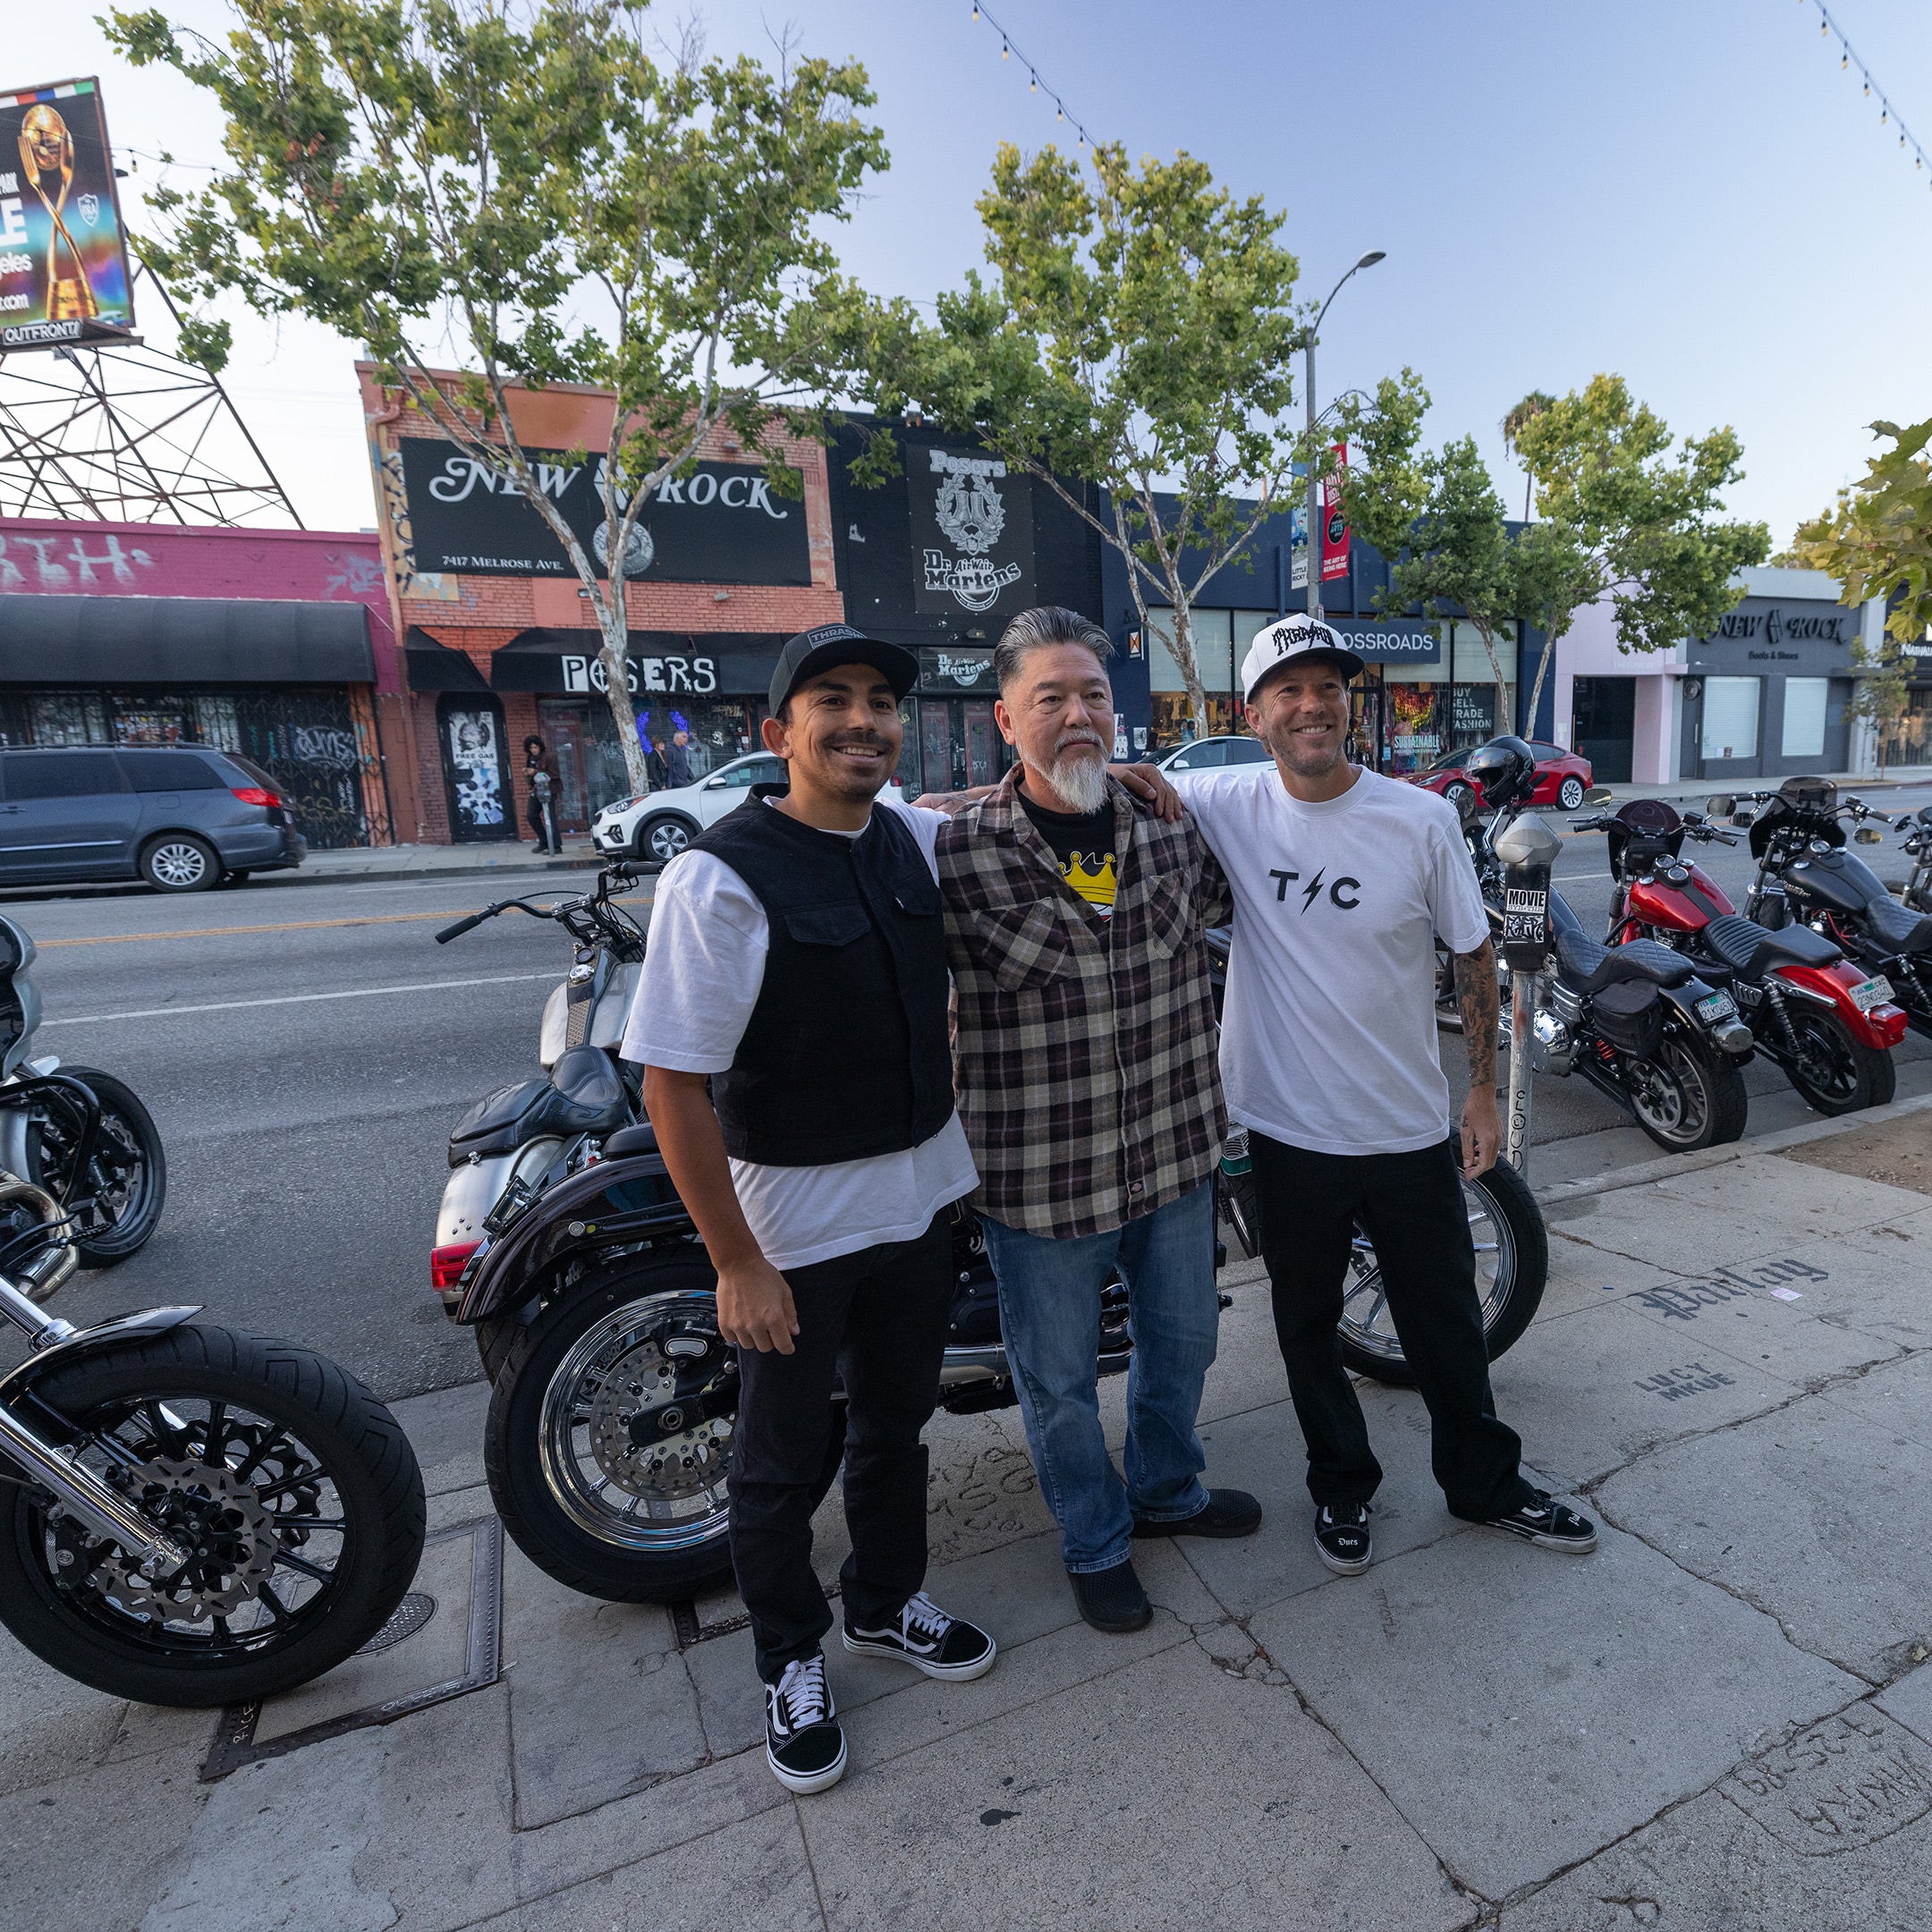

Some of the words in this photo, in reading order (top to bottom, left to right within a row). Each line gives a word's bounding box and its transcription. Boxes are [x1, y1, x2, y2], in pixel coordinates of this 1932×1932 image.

[442, 555, 469, 566] 7417
[470, 556, 533, 569] MELROSE
[925, 562, 1021, 590] Martens
[1292, 566, 1307, 575] LITTLE
[1343, 632, 1434, 651] OSSROADS
[938, 659, 991, 676] Martens
[1453, 708, 1484, 718] RADE
[1453, 719, 1492, 730] ASHION
[1394, 734, 1440, 749] SUSTAINABLE
[1508, 890, 1546, 907] MOVIE
[1632, 1362, 1711, 1393] LUCY
